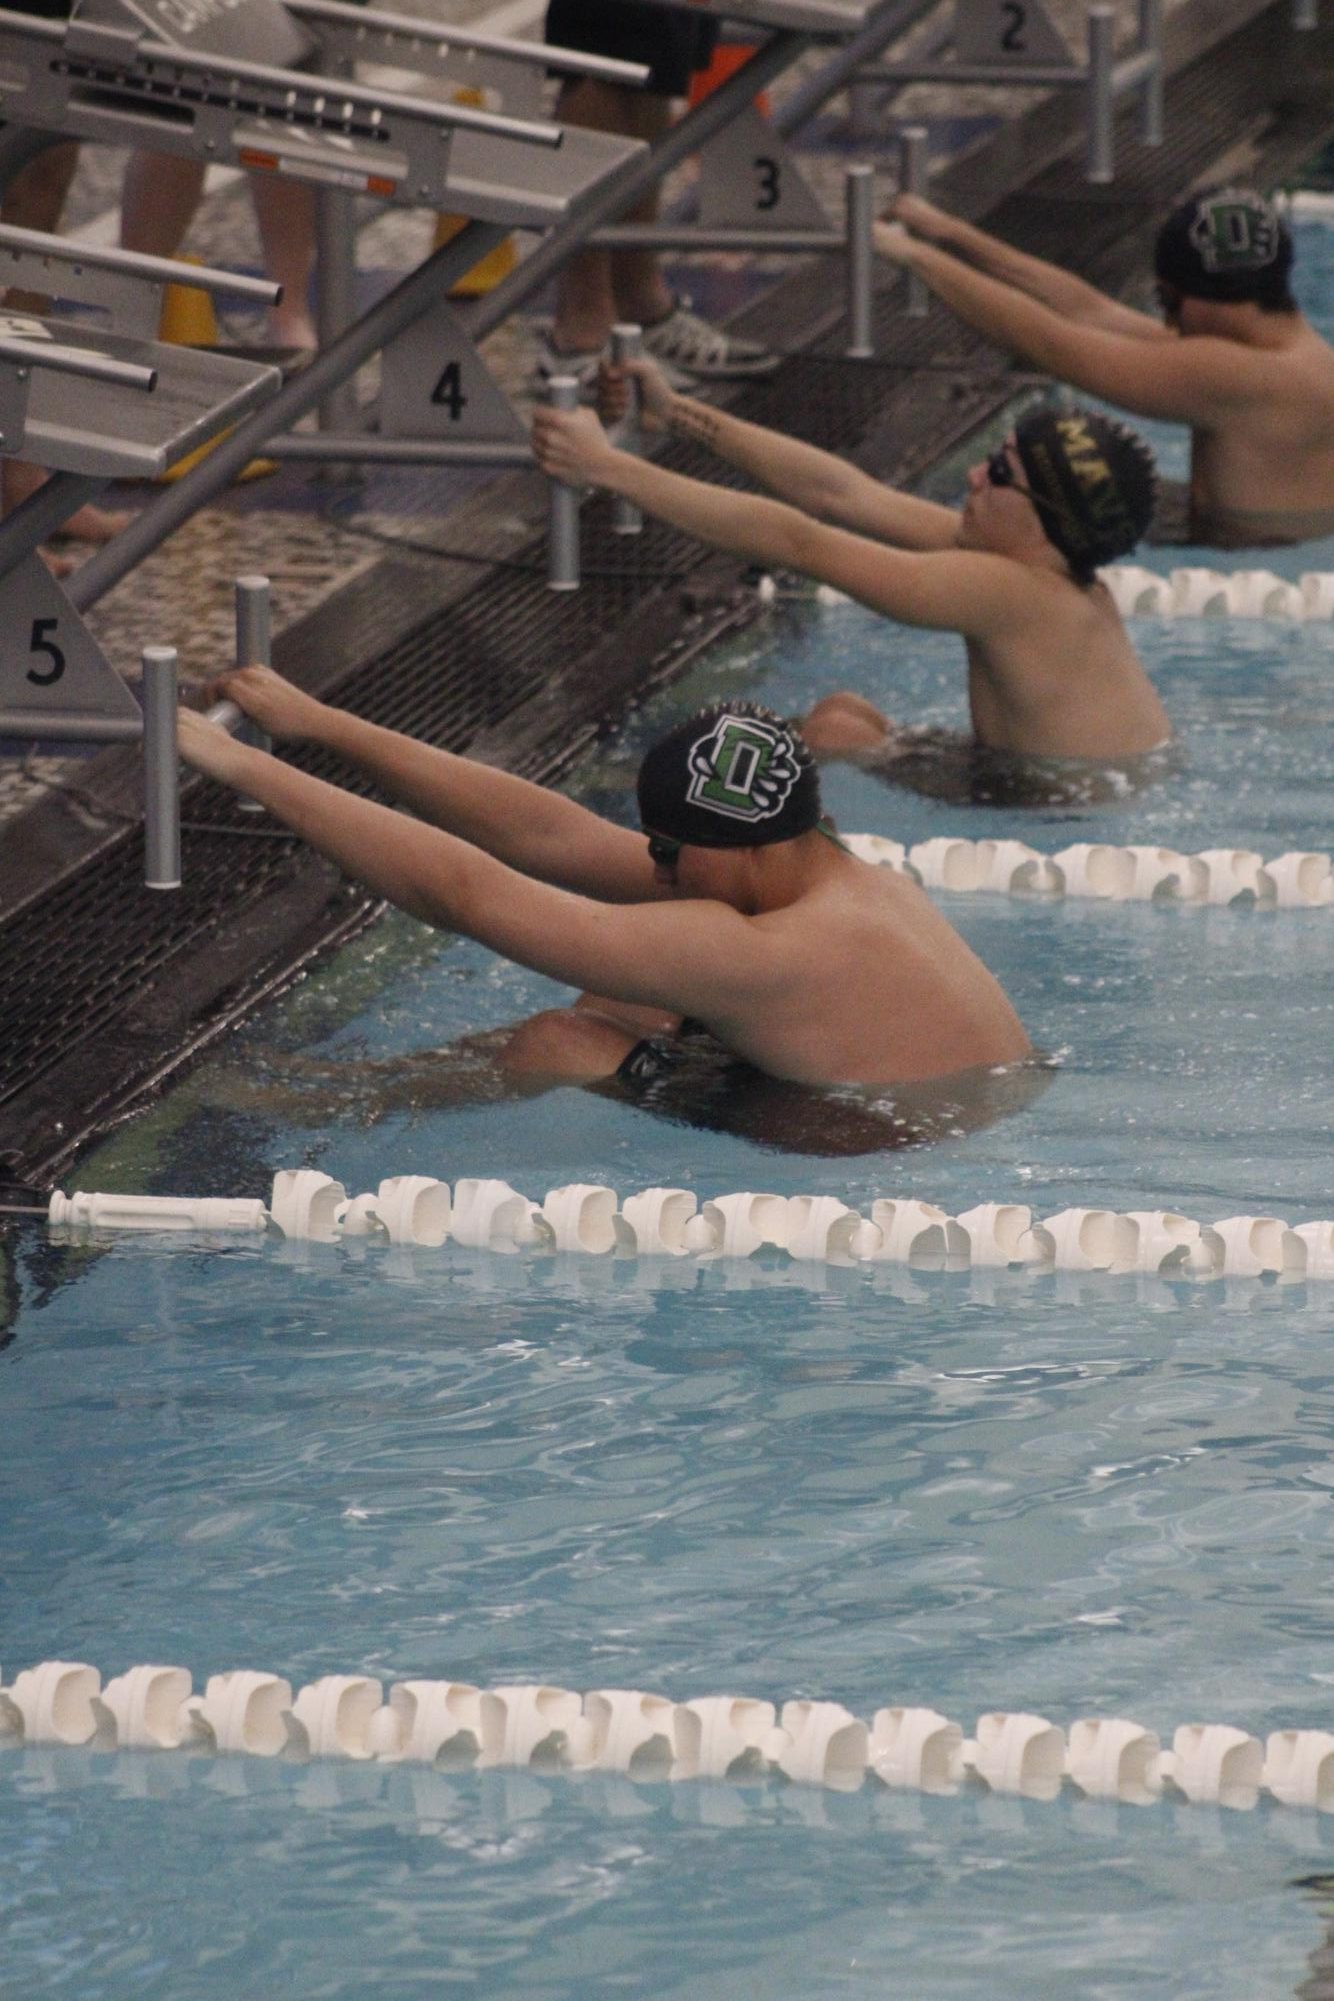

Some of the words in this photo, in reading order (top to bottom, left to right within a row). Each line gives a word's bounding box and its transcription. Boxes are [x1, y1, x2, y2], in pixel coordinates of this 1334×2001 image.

[1001, 2, 1025, 51] 2
[754, 156, 780, 210] 3
[430, 361, 468, 421] 4
[26, 618, 65, 686] 5
[690, 711, 786, 822] D
